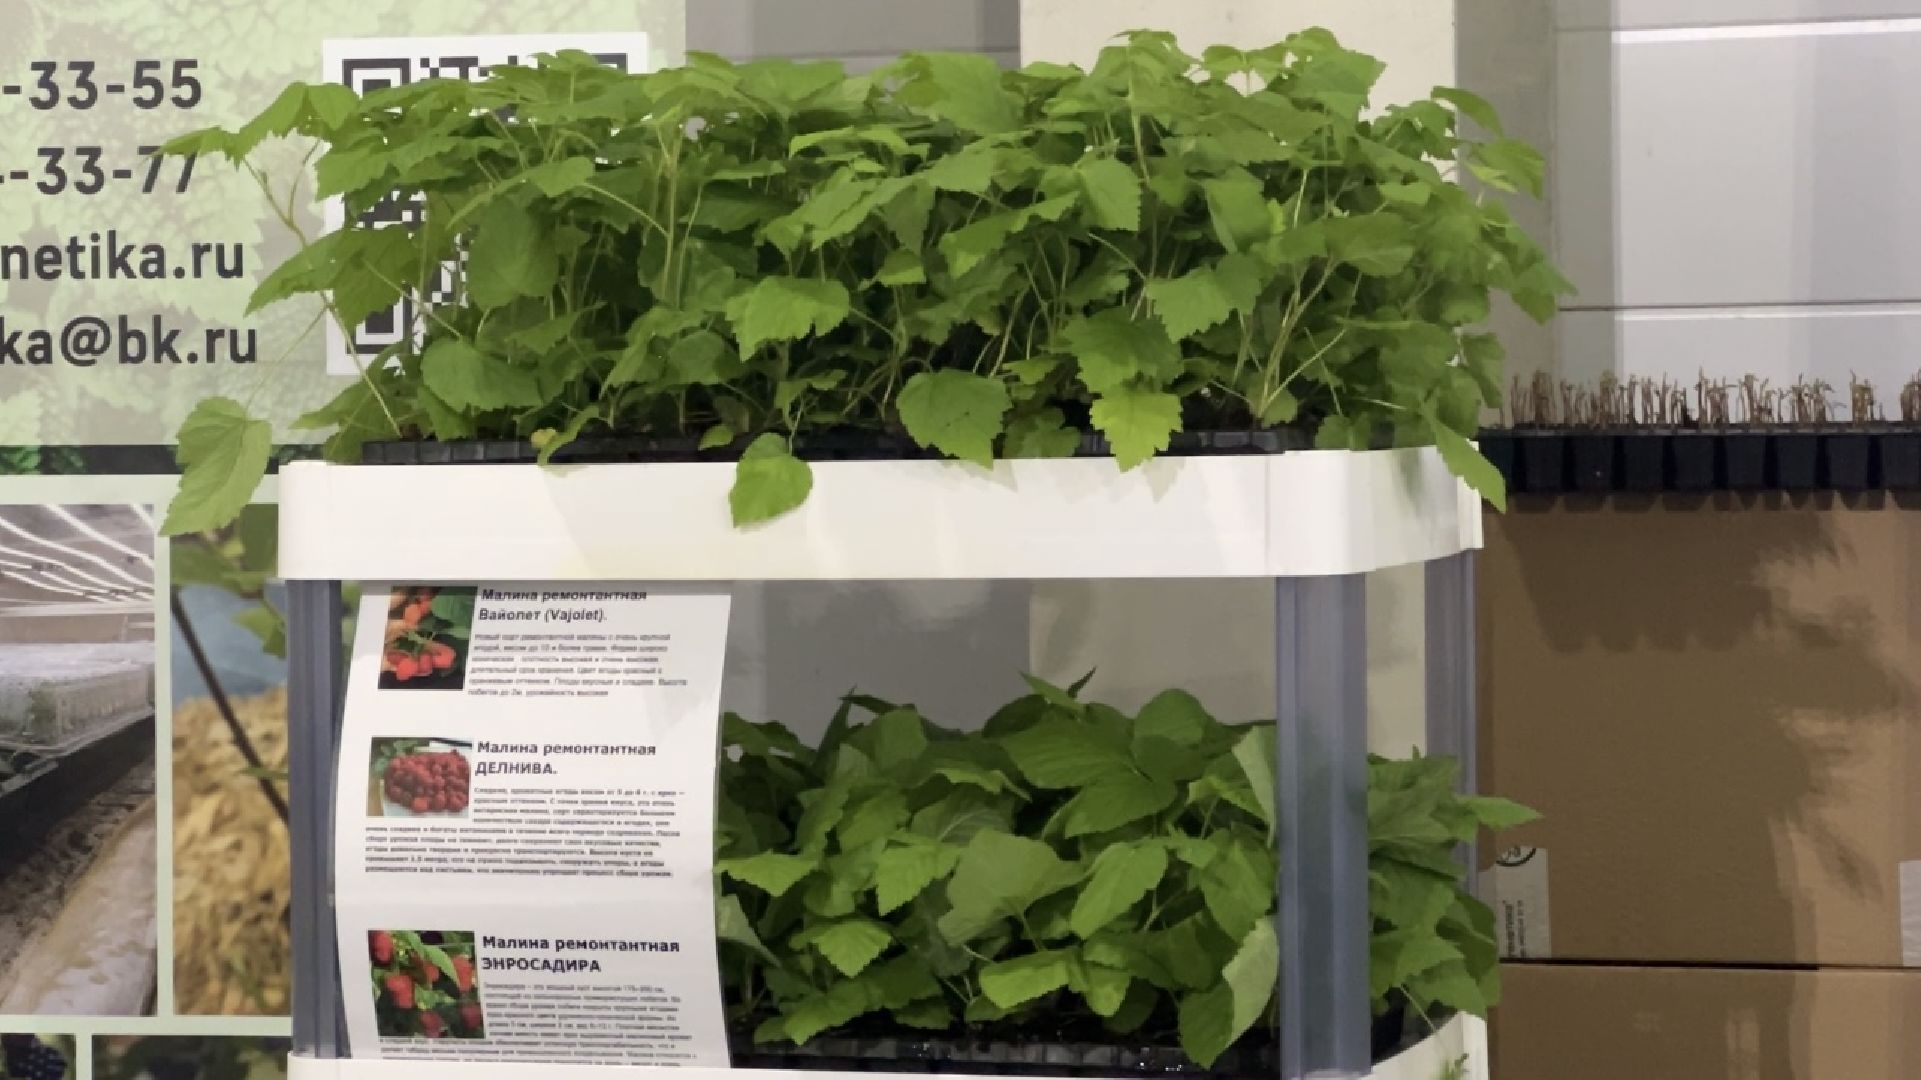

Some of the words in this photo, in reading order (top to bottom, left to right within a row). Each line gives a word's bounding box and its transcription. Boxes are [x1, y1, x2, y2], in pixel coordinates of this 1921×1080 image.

[2, 59, 202, 110] -33-55
[0, 146, 199, 195] -33-77
[1, 229, 244, 281] netika.ru
[0, 314, 257, 367] ka@bk.ru
[481, 589, 539, 601] Малина
[543, 591, 648, 604] ремонтантная
[477, 741, 539, 754] Малина
[543, 744, 657, 756] ремонтантная
[475, 761, 558, 777] ДЕЛНИВА.
[482, 936, 550, 949] Малина
[555, 939, 680, 953] ремонтантная
[481, 957, 602, 973] ЭНРОСАДИРА
